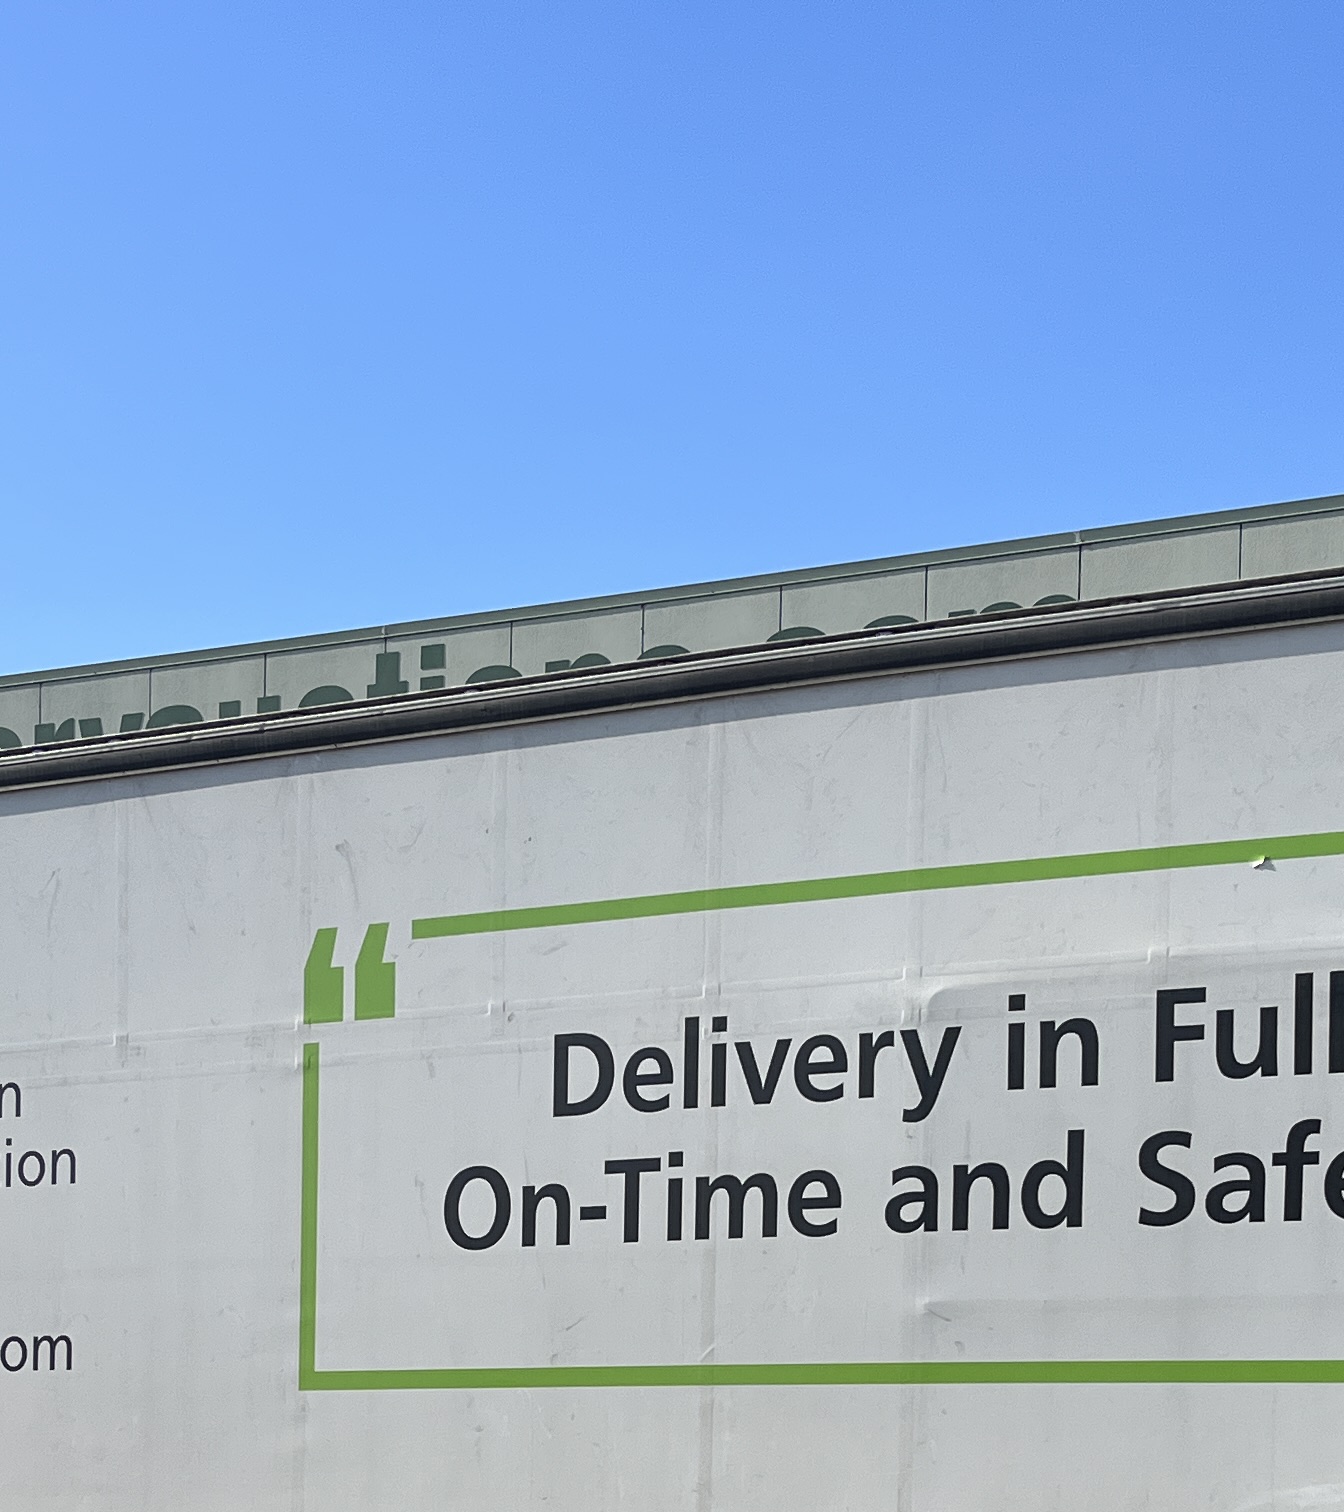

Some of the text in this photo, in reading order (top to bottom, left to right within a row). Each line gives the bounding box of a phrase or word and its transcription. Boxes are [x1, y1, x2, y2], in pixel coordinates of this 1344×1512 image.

[552, 1015, 963, 1123] Delivery
[1007, 993, 1100, 1091] in
[443, 1150, 842, 1251] On-Time
[884, 1130, 1085, 1234] and
